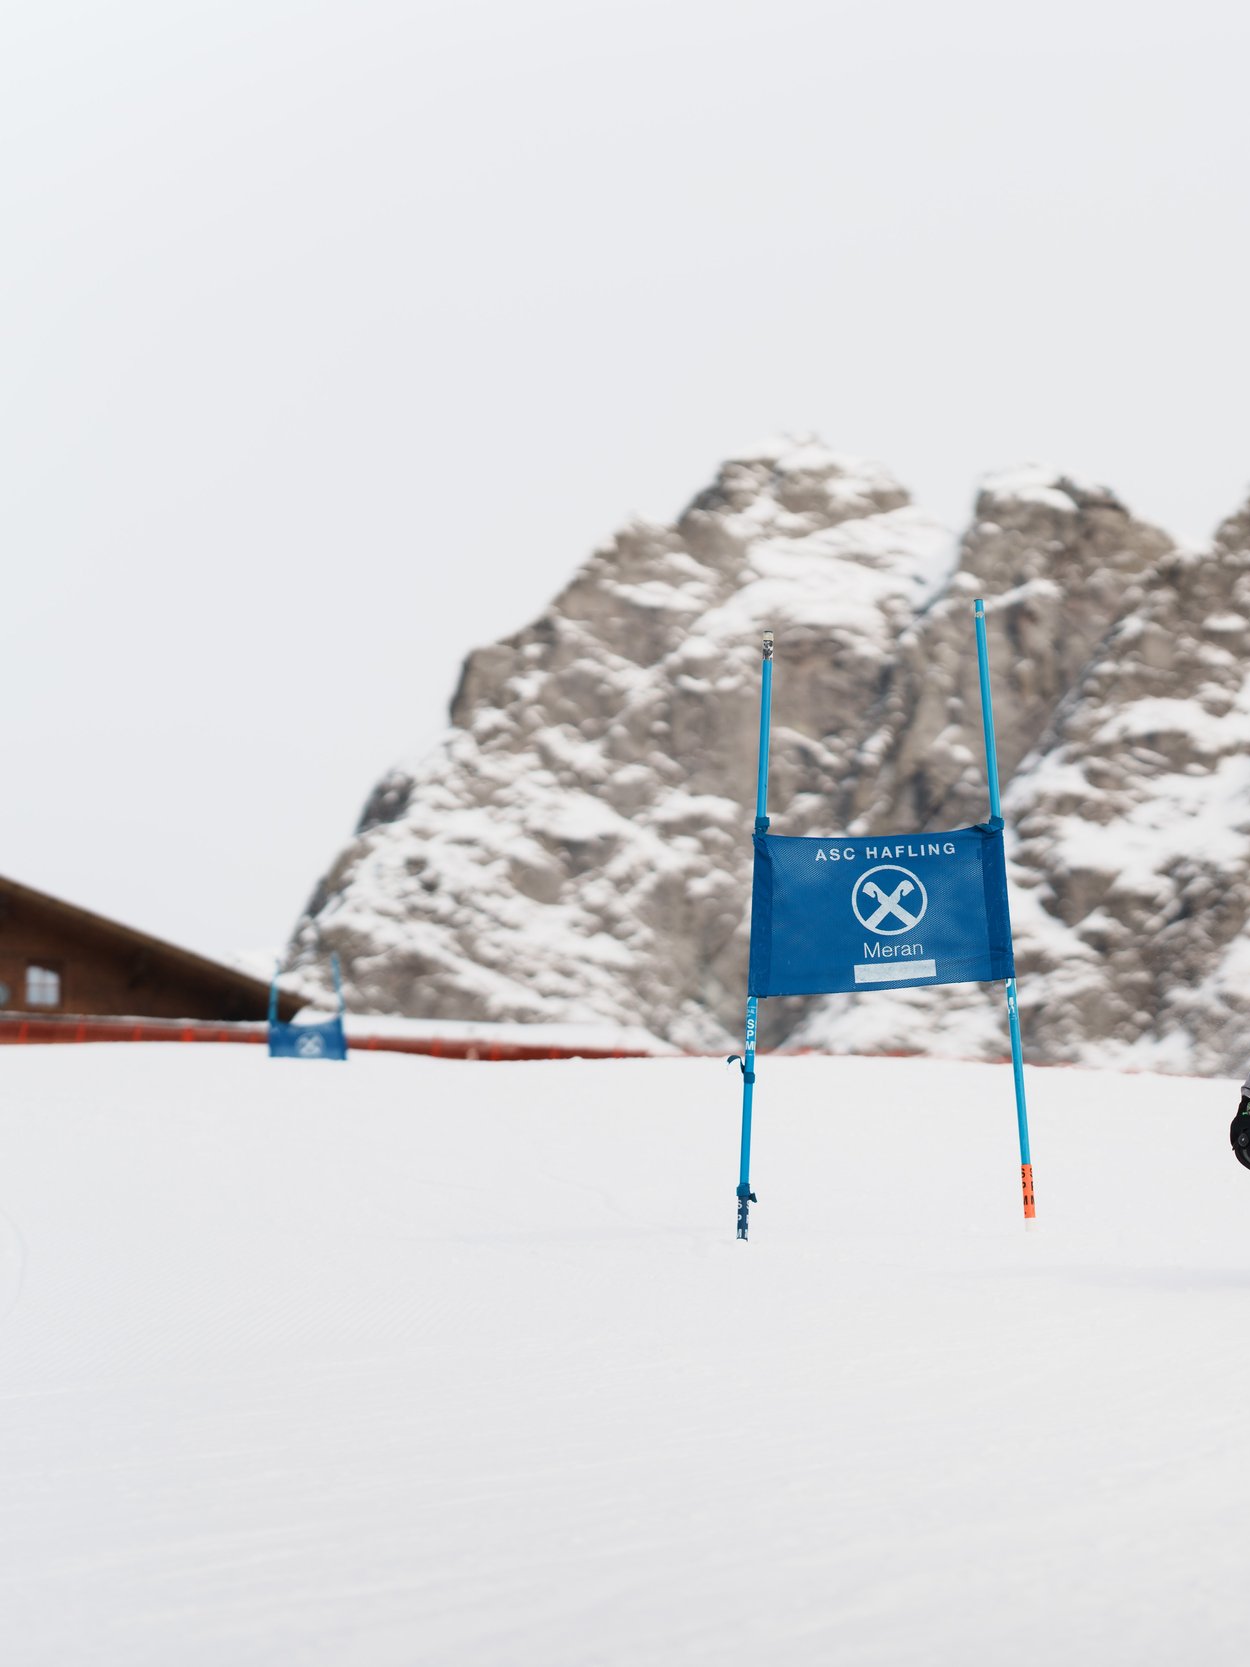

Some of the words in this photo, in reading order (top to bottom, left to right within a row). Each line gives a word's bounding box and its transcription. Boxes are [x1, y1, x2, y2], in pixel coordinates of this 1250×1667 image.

[815, 847, 855, 862] ASC
[866, 842, 956, 859] HAFLING
[863, 942, 923, 959] Meran
[745, 1018, 755, 1050] SPM
